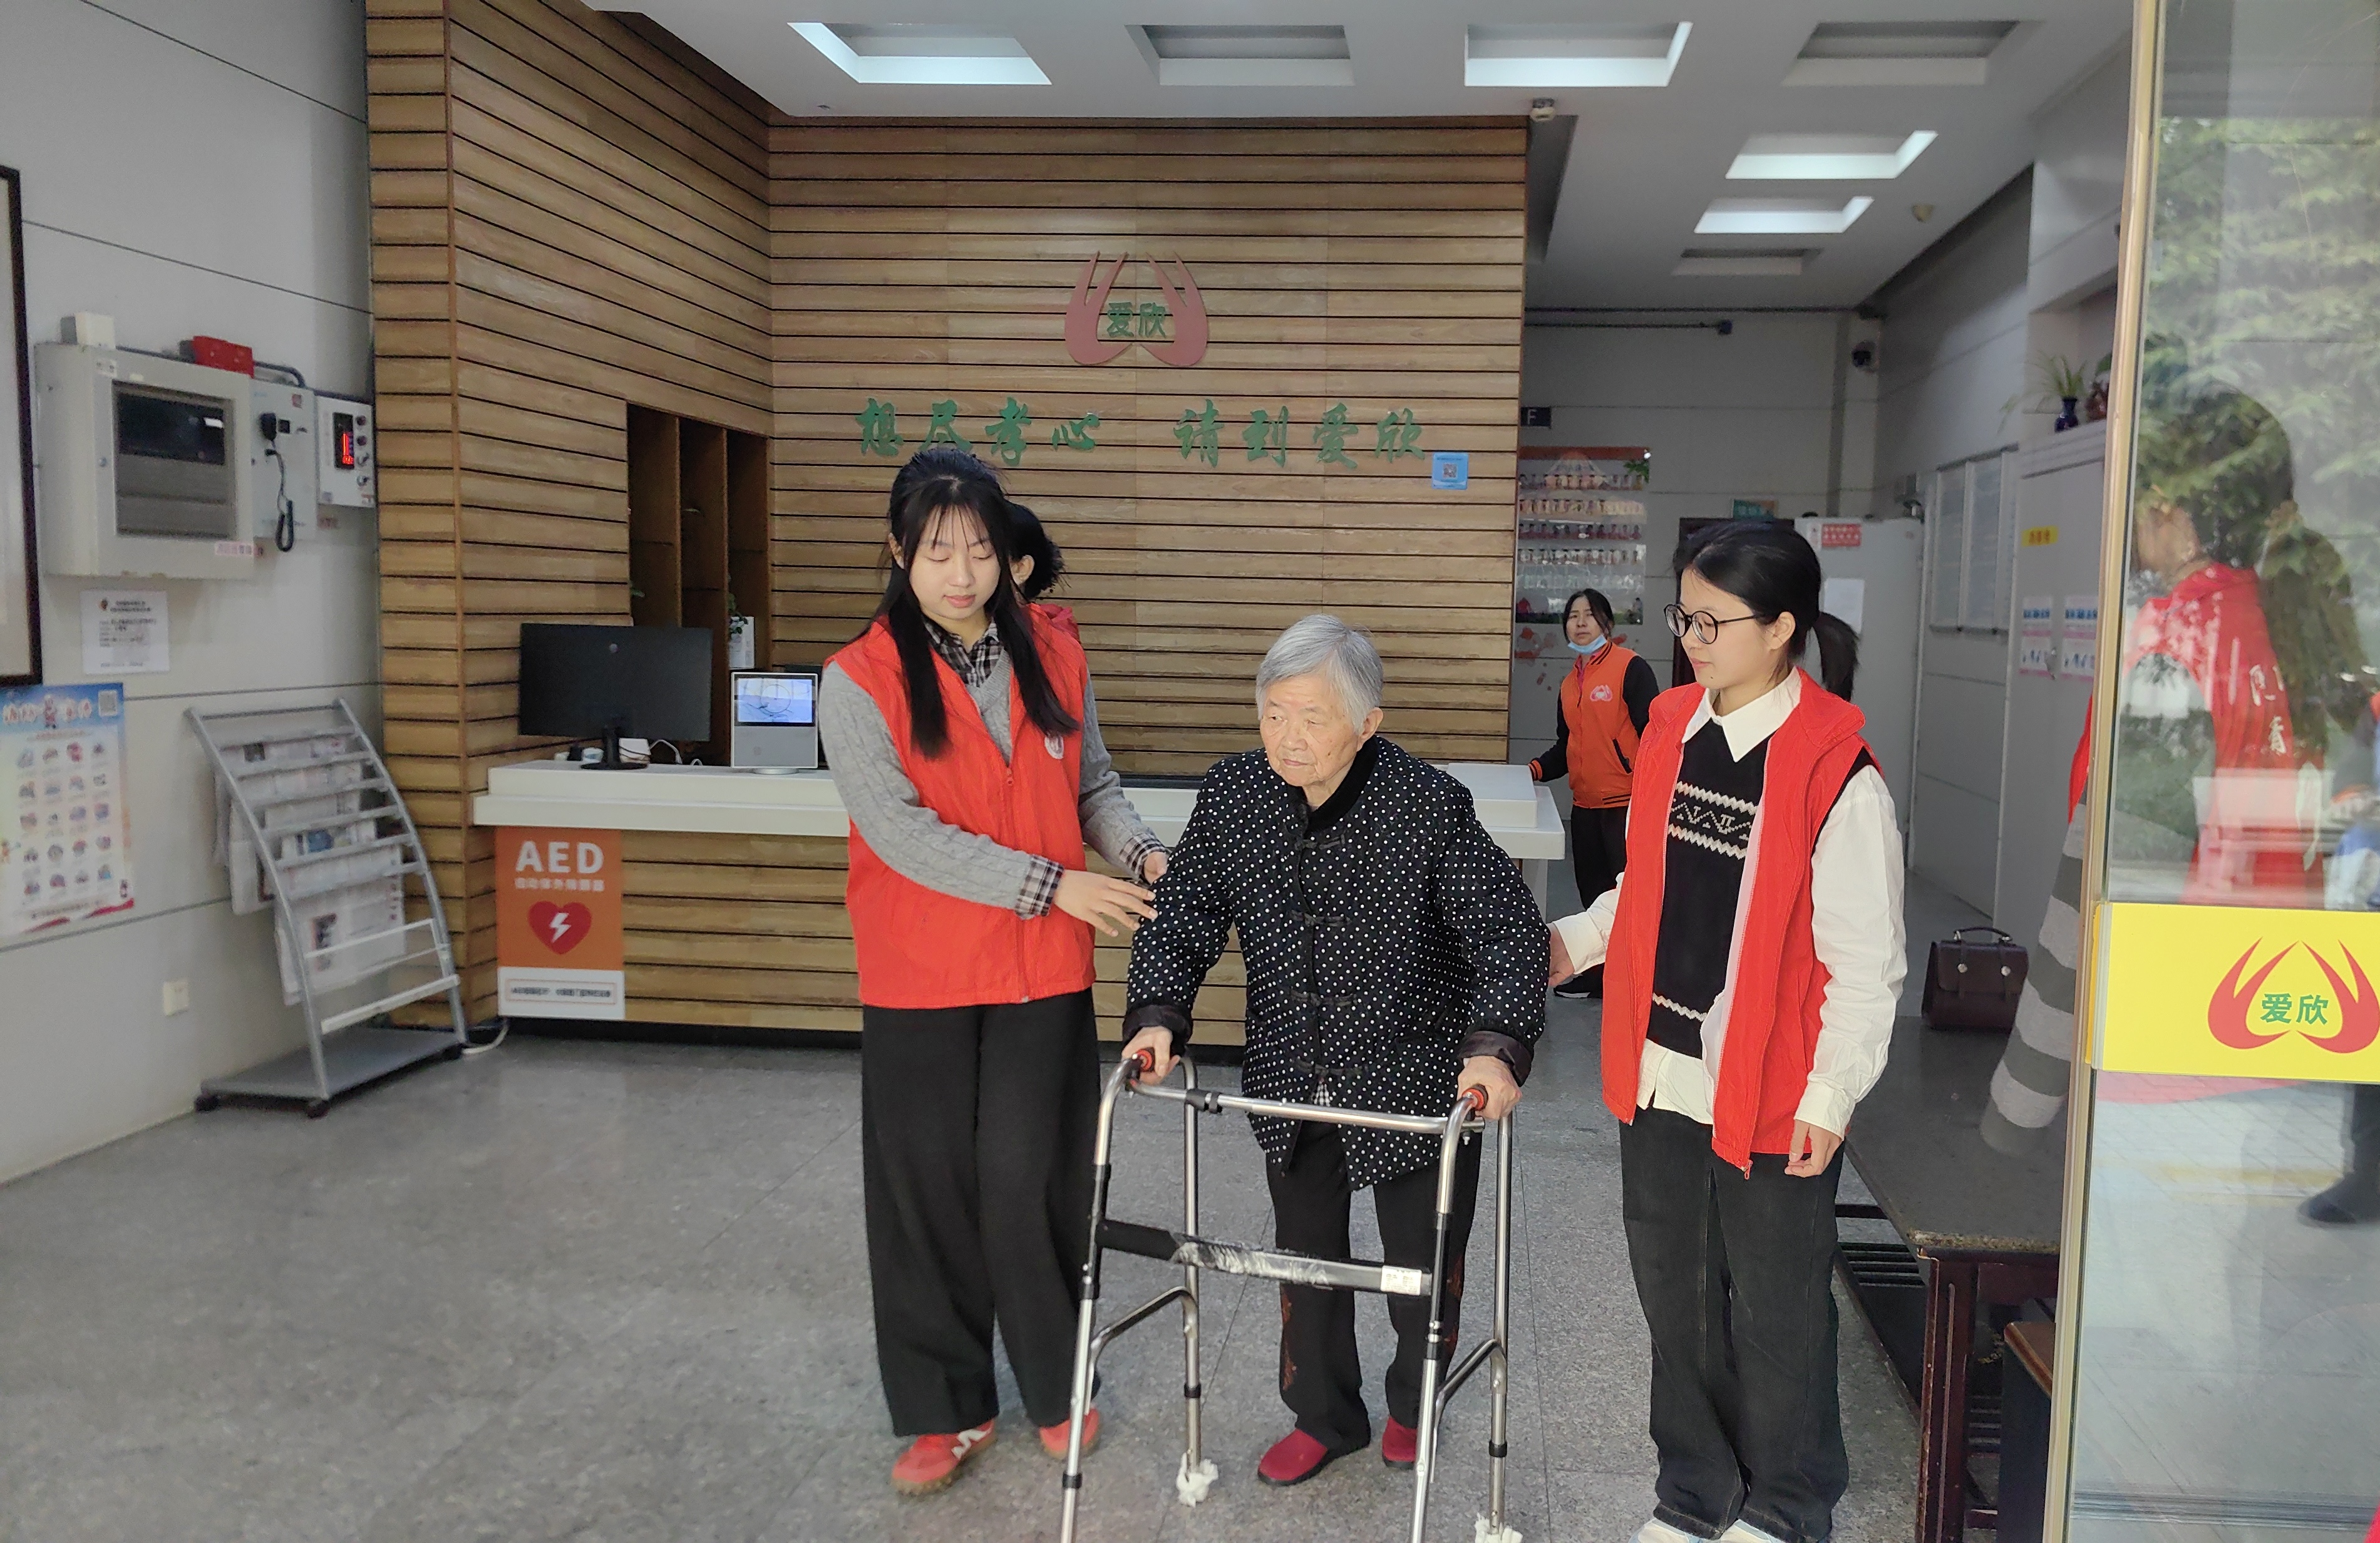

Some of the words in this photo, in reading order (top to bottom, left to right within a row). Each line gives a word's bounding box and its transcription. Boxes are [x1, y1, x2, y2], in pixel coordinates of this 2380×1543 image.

[1106, 302, 1167, 338] 爱欣
[855, 396, 1100, 466] 想尽孝心
[1173, 398, 1425, 469] 请到爱欣
[515, 840, 604, 874] AED
[2260, 993, 2329, 1025] 爱欣
